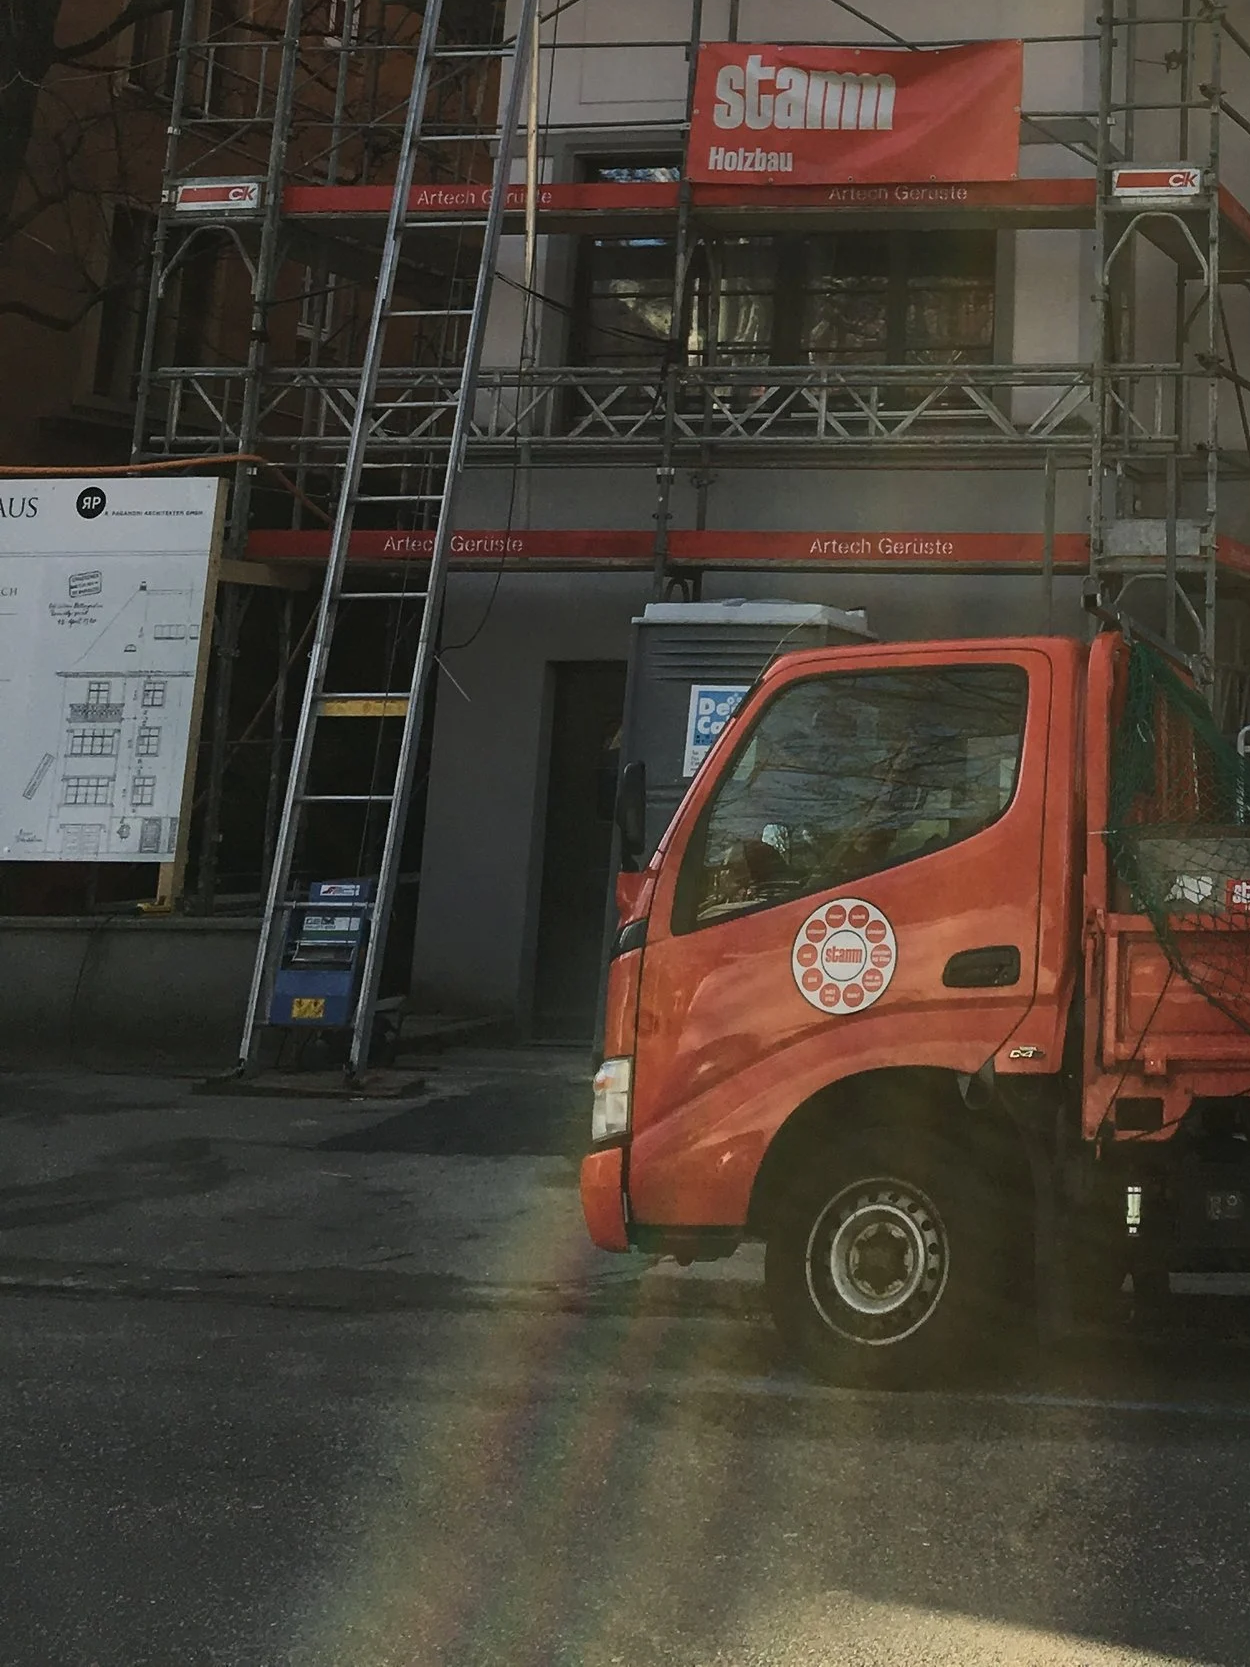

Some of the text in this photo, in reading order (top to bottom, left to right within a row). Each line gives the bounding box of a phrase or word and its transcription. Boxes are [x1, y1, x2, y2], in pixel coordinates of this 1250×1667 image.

[713, 54, 896, 130] stamm
[708, 146, 793, 172] Holzbau
[417, 190, 475, 205] Artech
[384, 535, 523, 552] Artec Gerüste
[810, 537, 953, 555] Artech Gerüste
[699, 697, 735, 715] De
